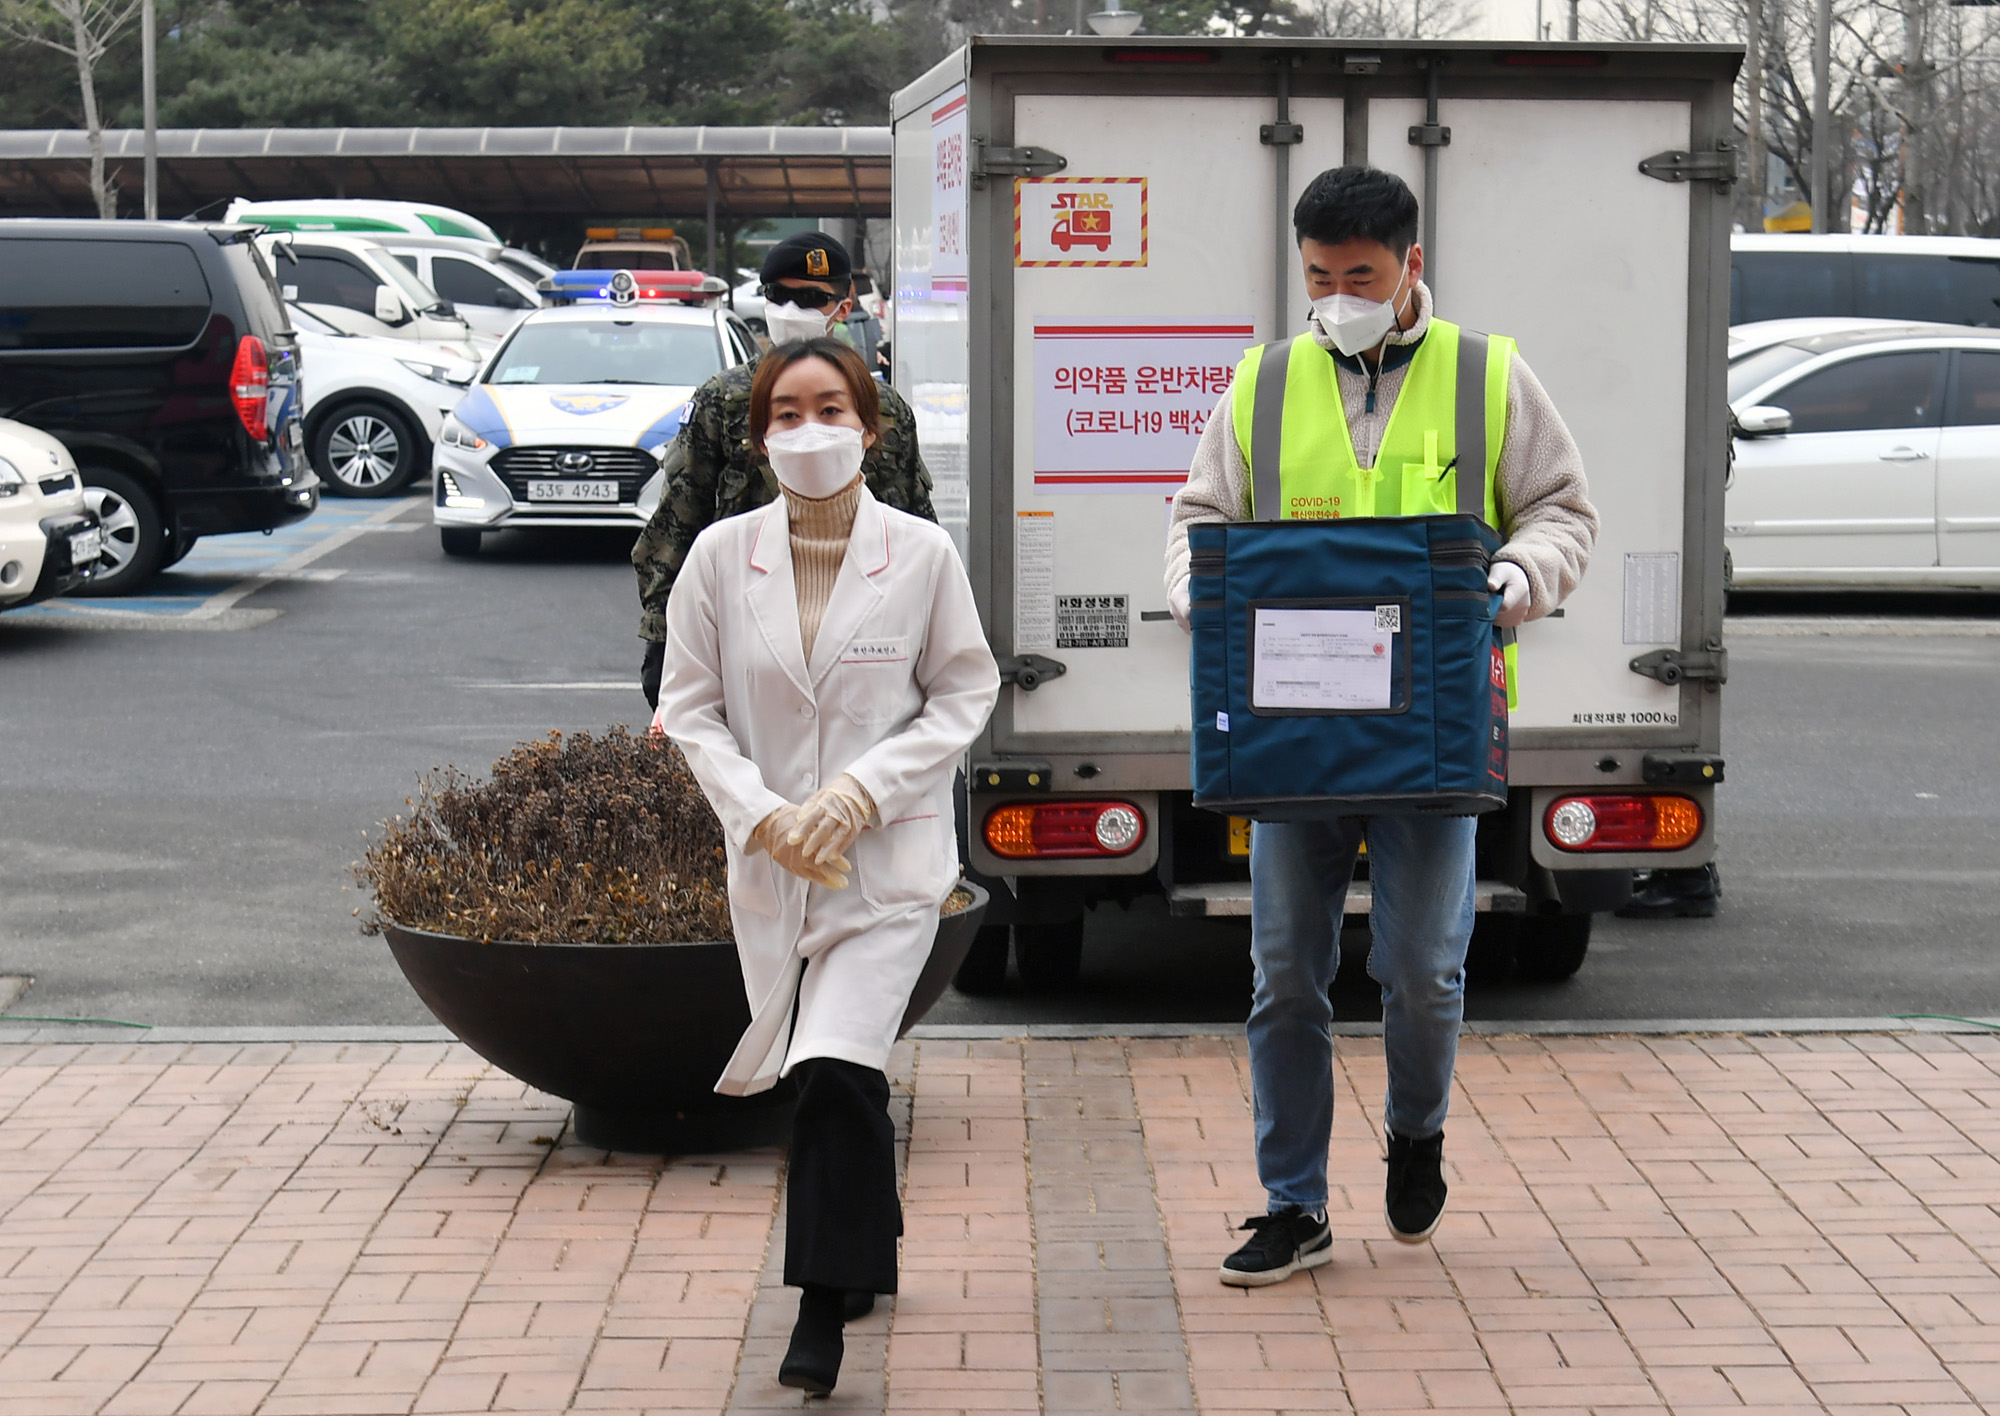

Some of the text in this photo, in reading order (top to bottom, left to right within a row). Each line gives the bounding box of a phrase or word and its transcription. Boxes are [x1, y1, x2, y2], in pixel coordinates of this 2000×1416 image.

[1051, 193, 1113, 209] STAR
[1054, 366, 1233, 394] 의약품 운반차량
[1066, 409, 1213, 436] (코로나19 백신
[572, 483, 610, 498] 4943
[1291, 496, 1340, 507] COVID-19
[1572, 712, 1677, 724] 최대적재량 1000 kg
